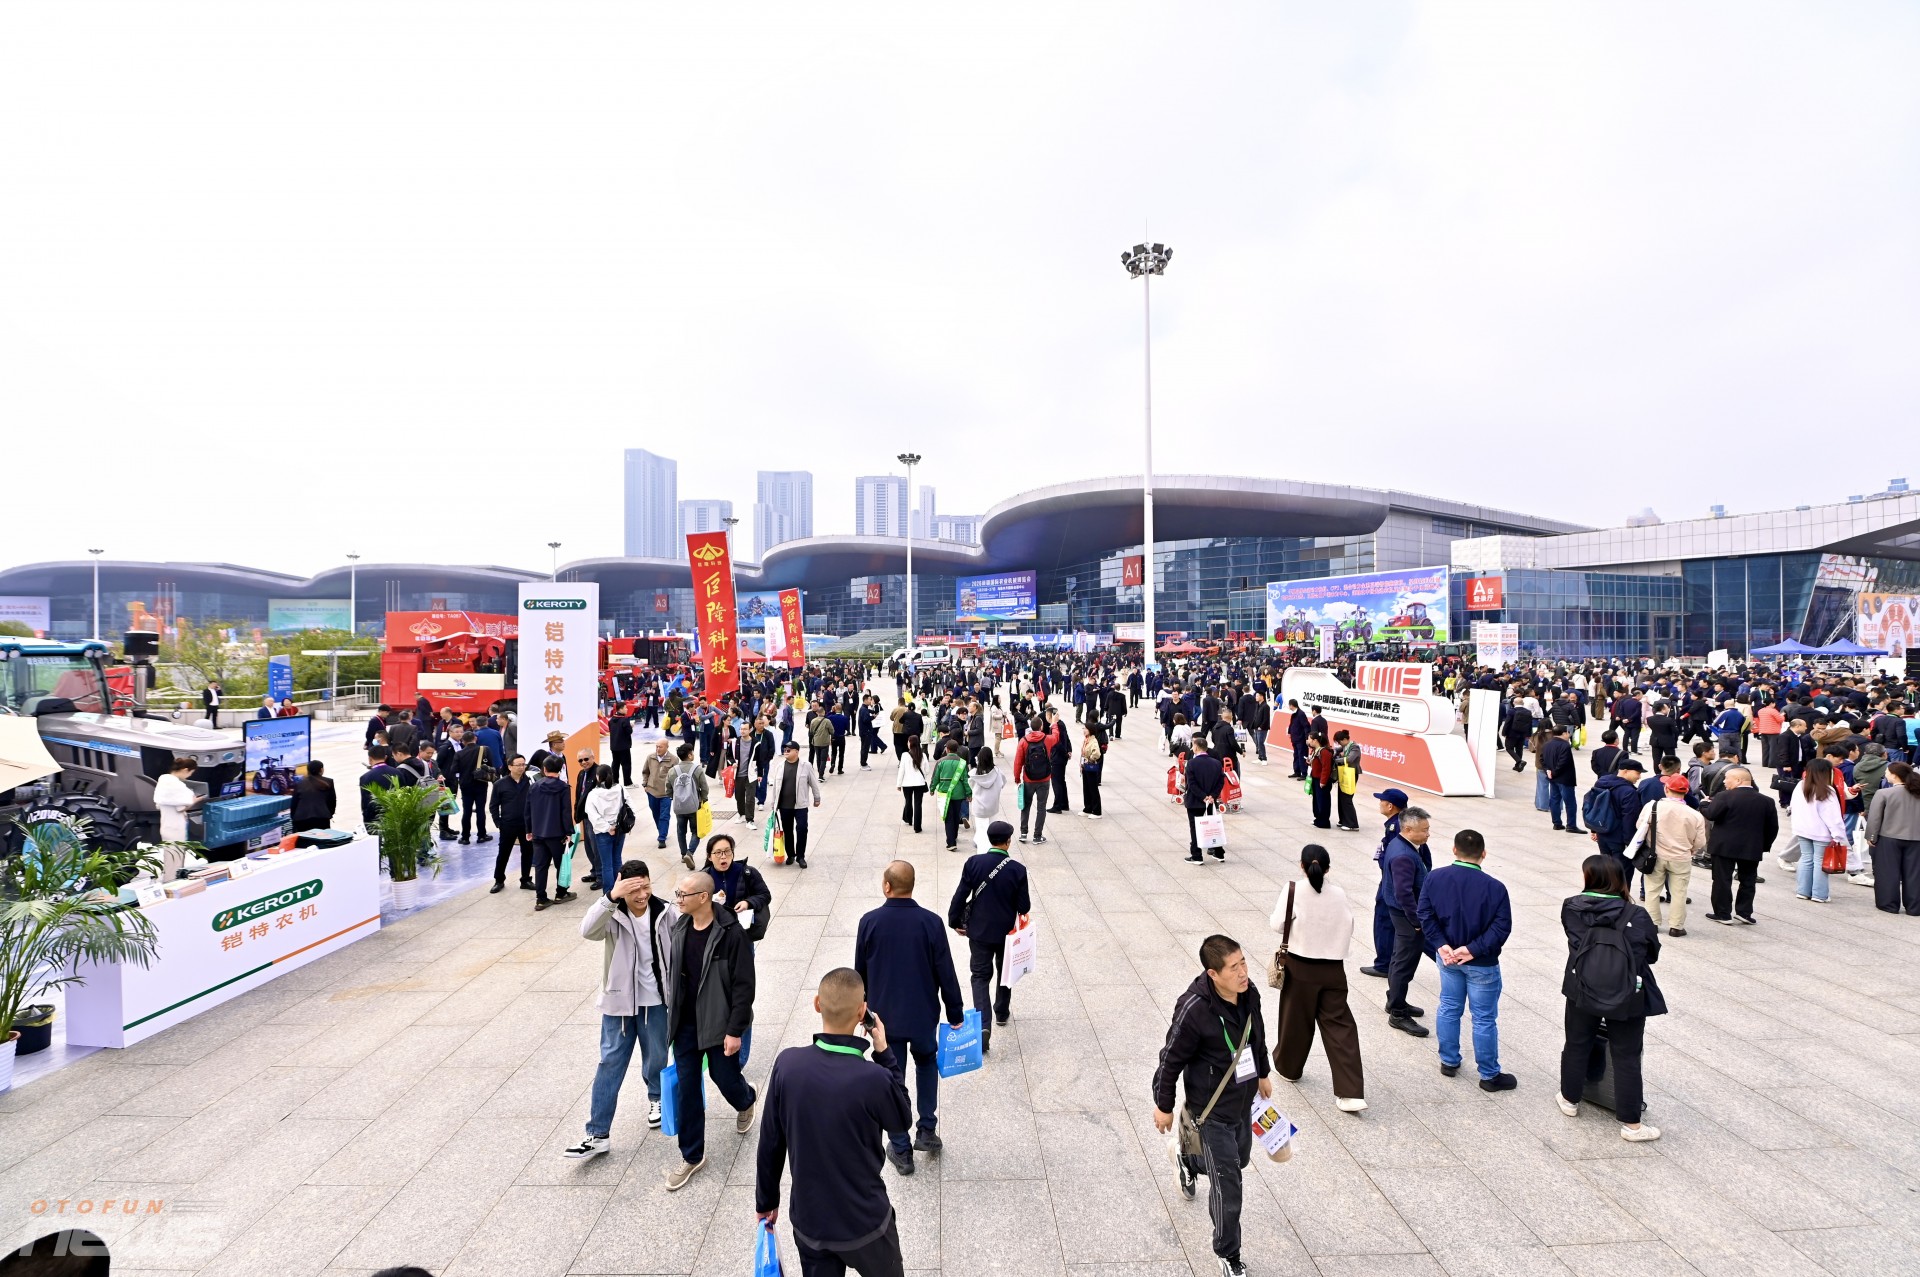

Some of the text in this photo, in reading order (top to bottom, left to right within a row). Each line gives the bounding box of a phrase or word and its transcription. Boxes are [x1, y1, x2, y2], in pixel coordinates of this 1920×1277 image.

[1125, 563, 1140, 578] A1
[867, 588, 879, 599] A2
[1473, 595, 1494, 603] 登录厅
[432, 603, 444, 611] A4
[536, 600, 583, 608] KEROTY
[655, 599, 667, 608] A3
[544, 621, 565, 722] 铠特农机
[1302, 691, 1401, 714] 2025中国国际农业机械展览会
[1350, 709, 1370, 718] Machinery
[1370, 711, 1390, 720] Exhibition
[237, 882, 318, 920] KEROTY
[221, 904, 318, 952] 铠特农机
